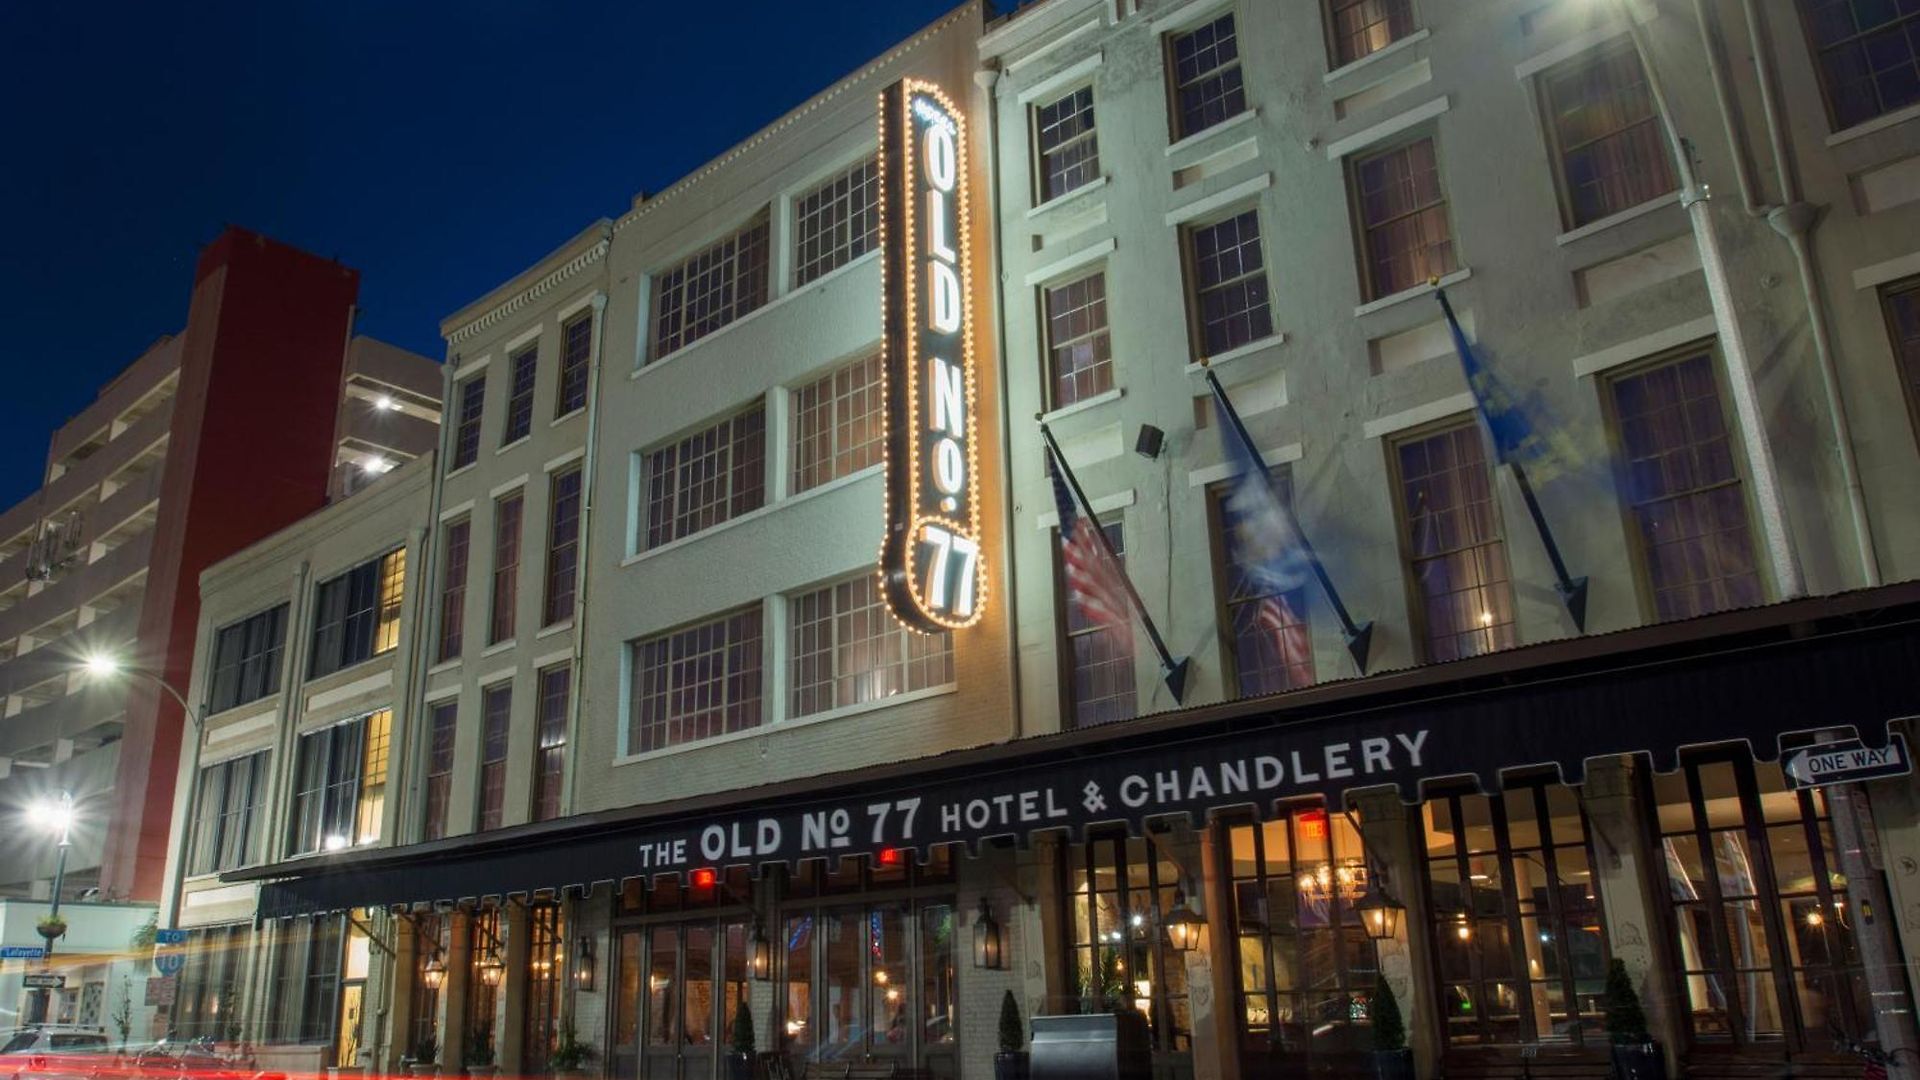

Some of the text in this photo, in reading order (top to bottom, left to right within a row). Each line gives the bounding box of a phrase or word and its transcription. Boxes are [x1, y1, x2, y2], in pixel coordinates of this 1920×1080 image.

[924, 124, 960, 334] OLD
[920, 525, 979, 617] 77
[1808, 748, 1889, 773] ONE WAY
[639, 838, 687, 868] THE
[700, 818, 781, 861] OLD
[867, 797, 921, 843] 77
[941, 788, 1068, 833] HOTEL
[1083, 780, 1106, 814] &
[1120, 730, 1428, 807] CHANDLERY
[159, 954, 178, 970] 10
[164, 931, 180, 941] TO
